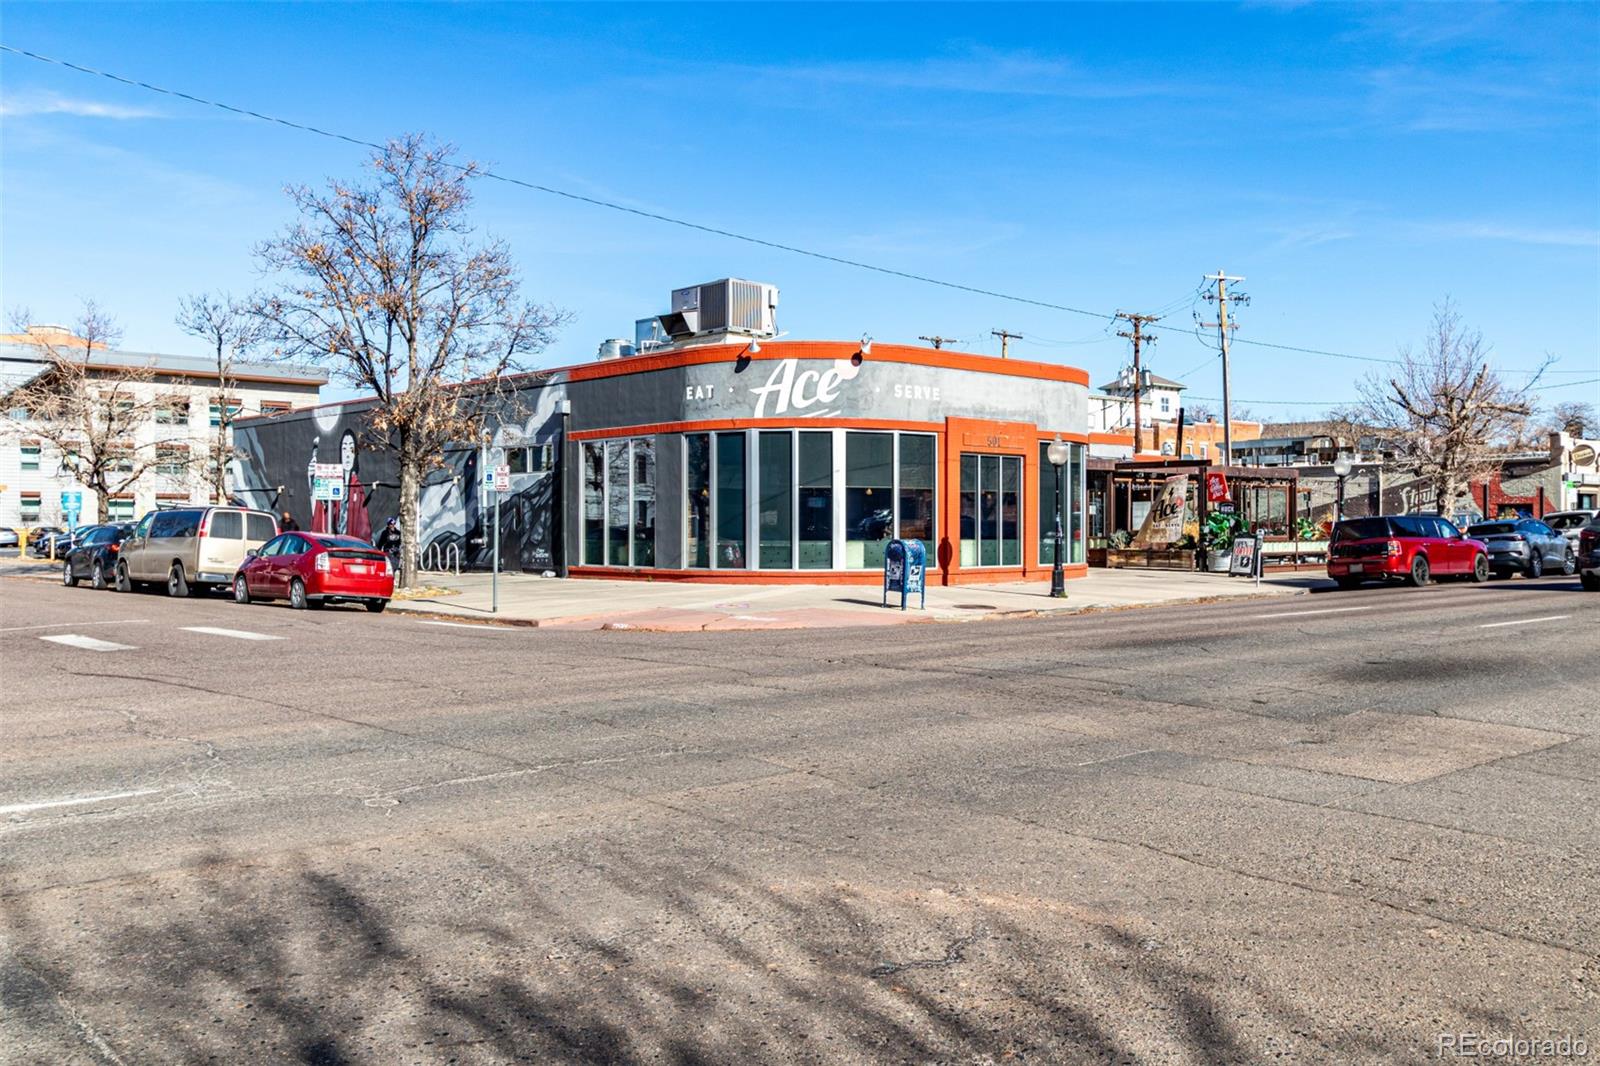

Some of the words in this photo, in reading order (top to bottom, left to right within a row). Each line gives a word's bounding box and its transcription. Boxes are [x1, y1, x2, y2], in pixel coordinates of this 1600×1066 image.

[686, 385, 714, 401] EAT
[750, 358, 842, 419] Ace
[893, 383, 942, 401] SERVE
[1152, 499, 1179, 523] Ace
